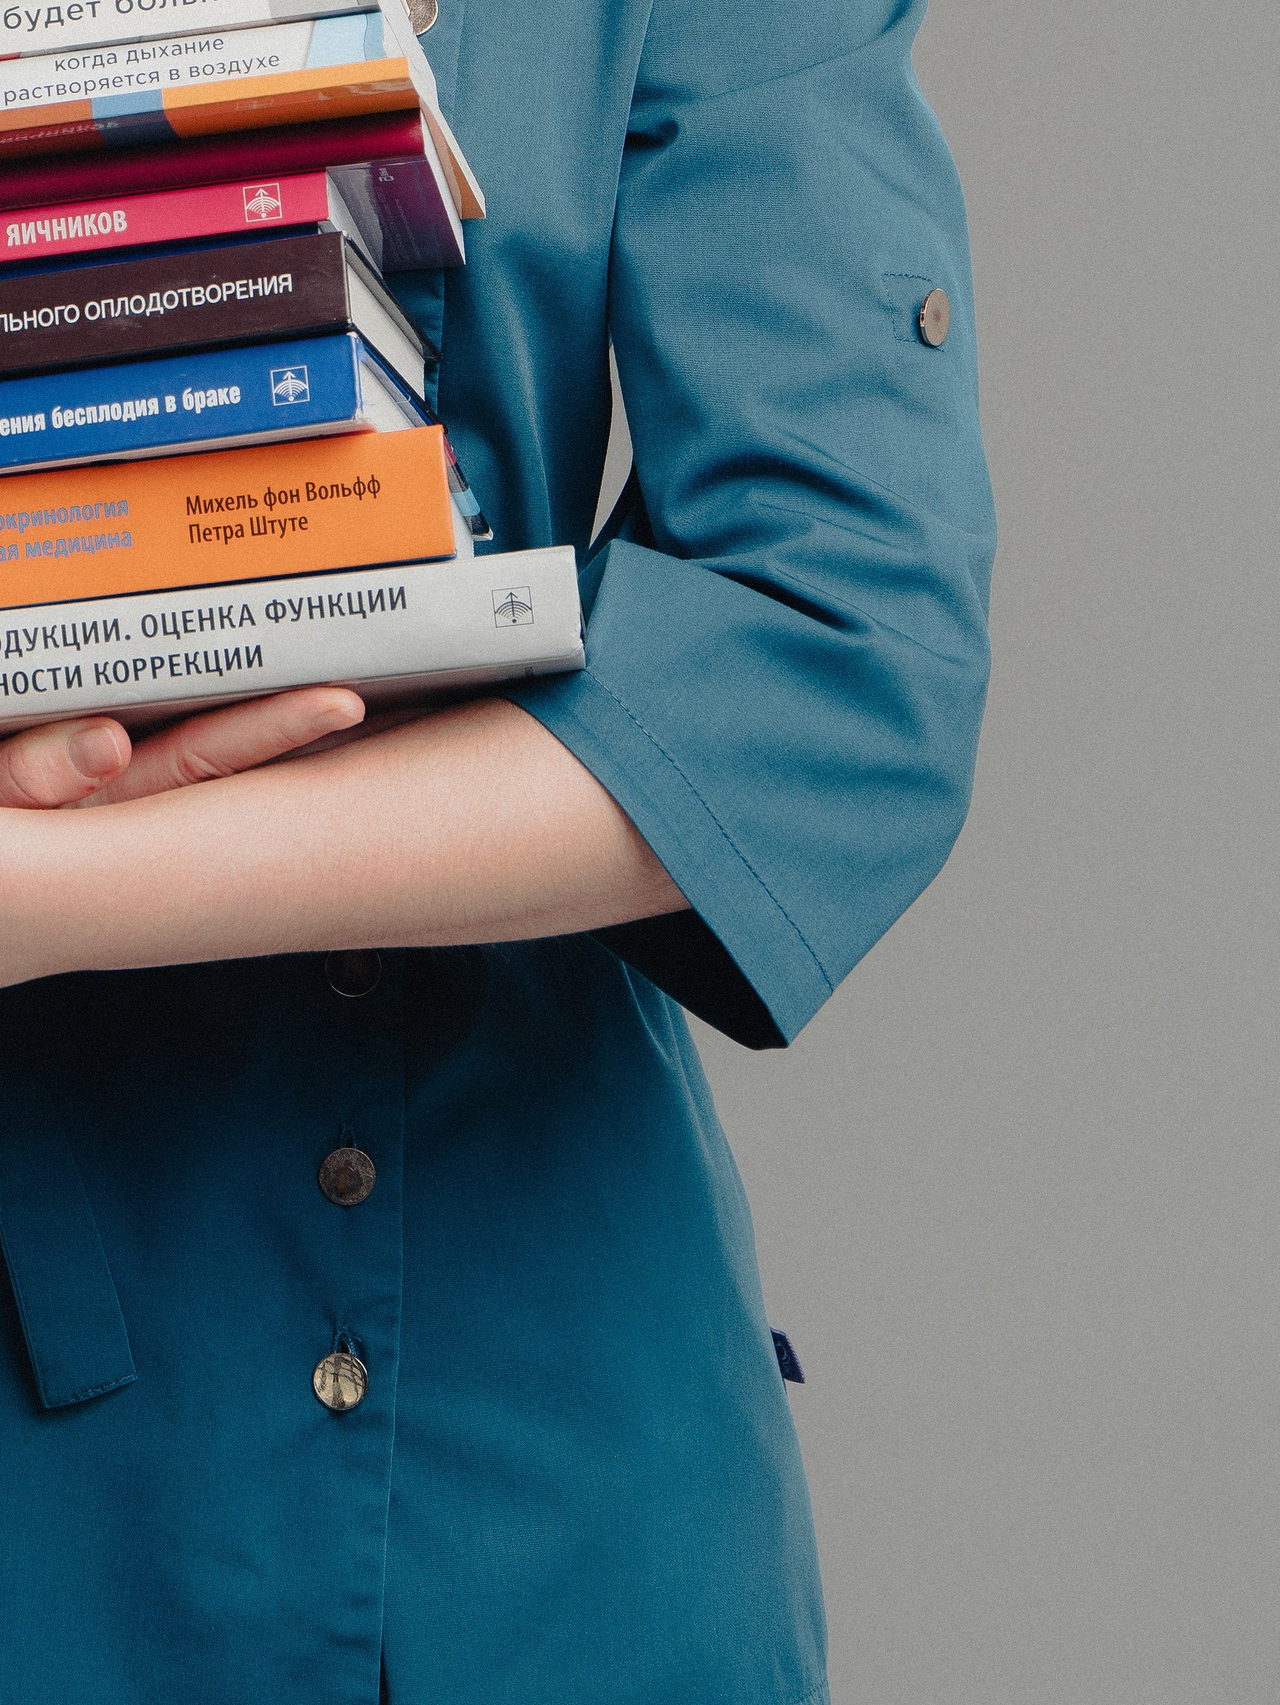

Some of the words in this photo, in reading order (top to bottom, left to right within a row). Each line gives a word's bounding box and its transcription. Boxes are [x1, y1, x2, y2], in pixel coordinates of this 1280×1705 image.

[3, 0, 101, 32] будет
[54, 54, 118, 71] когда
[125, 36, 225, 66] дыхание
[3, 71, 160, 106] растворяется
[169, 69, 181, 82] в
[189, 53, 281, 81] воздухе
[7, 210, 128, 245] ЯИЧНИКОВ
[84, 273, 293, 321] ОПЛОДОТВОРЕНИЯ
[51, 397, 161, 431] бесплодия
[166, 395, 177, 412] в
[182, 384, 242, 413] браке
[186, 491, 259, 517] Михель
[263, 487, 301, 510] фон
[306, 474, 382, 503] Вольфф
[25, 528, 132, 560] медицина
[188, 521, 246, 545] Петра
[249, 513, 309, 541] Штуте
[140, 601, 256, 641] ОЦЕНКА
[264, 585, 408, 625] ФУНКЦИИ
[94, 644, 264, 687] КОРРЕКЦИИ
